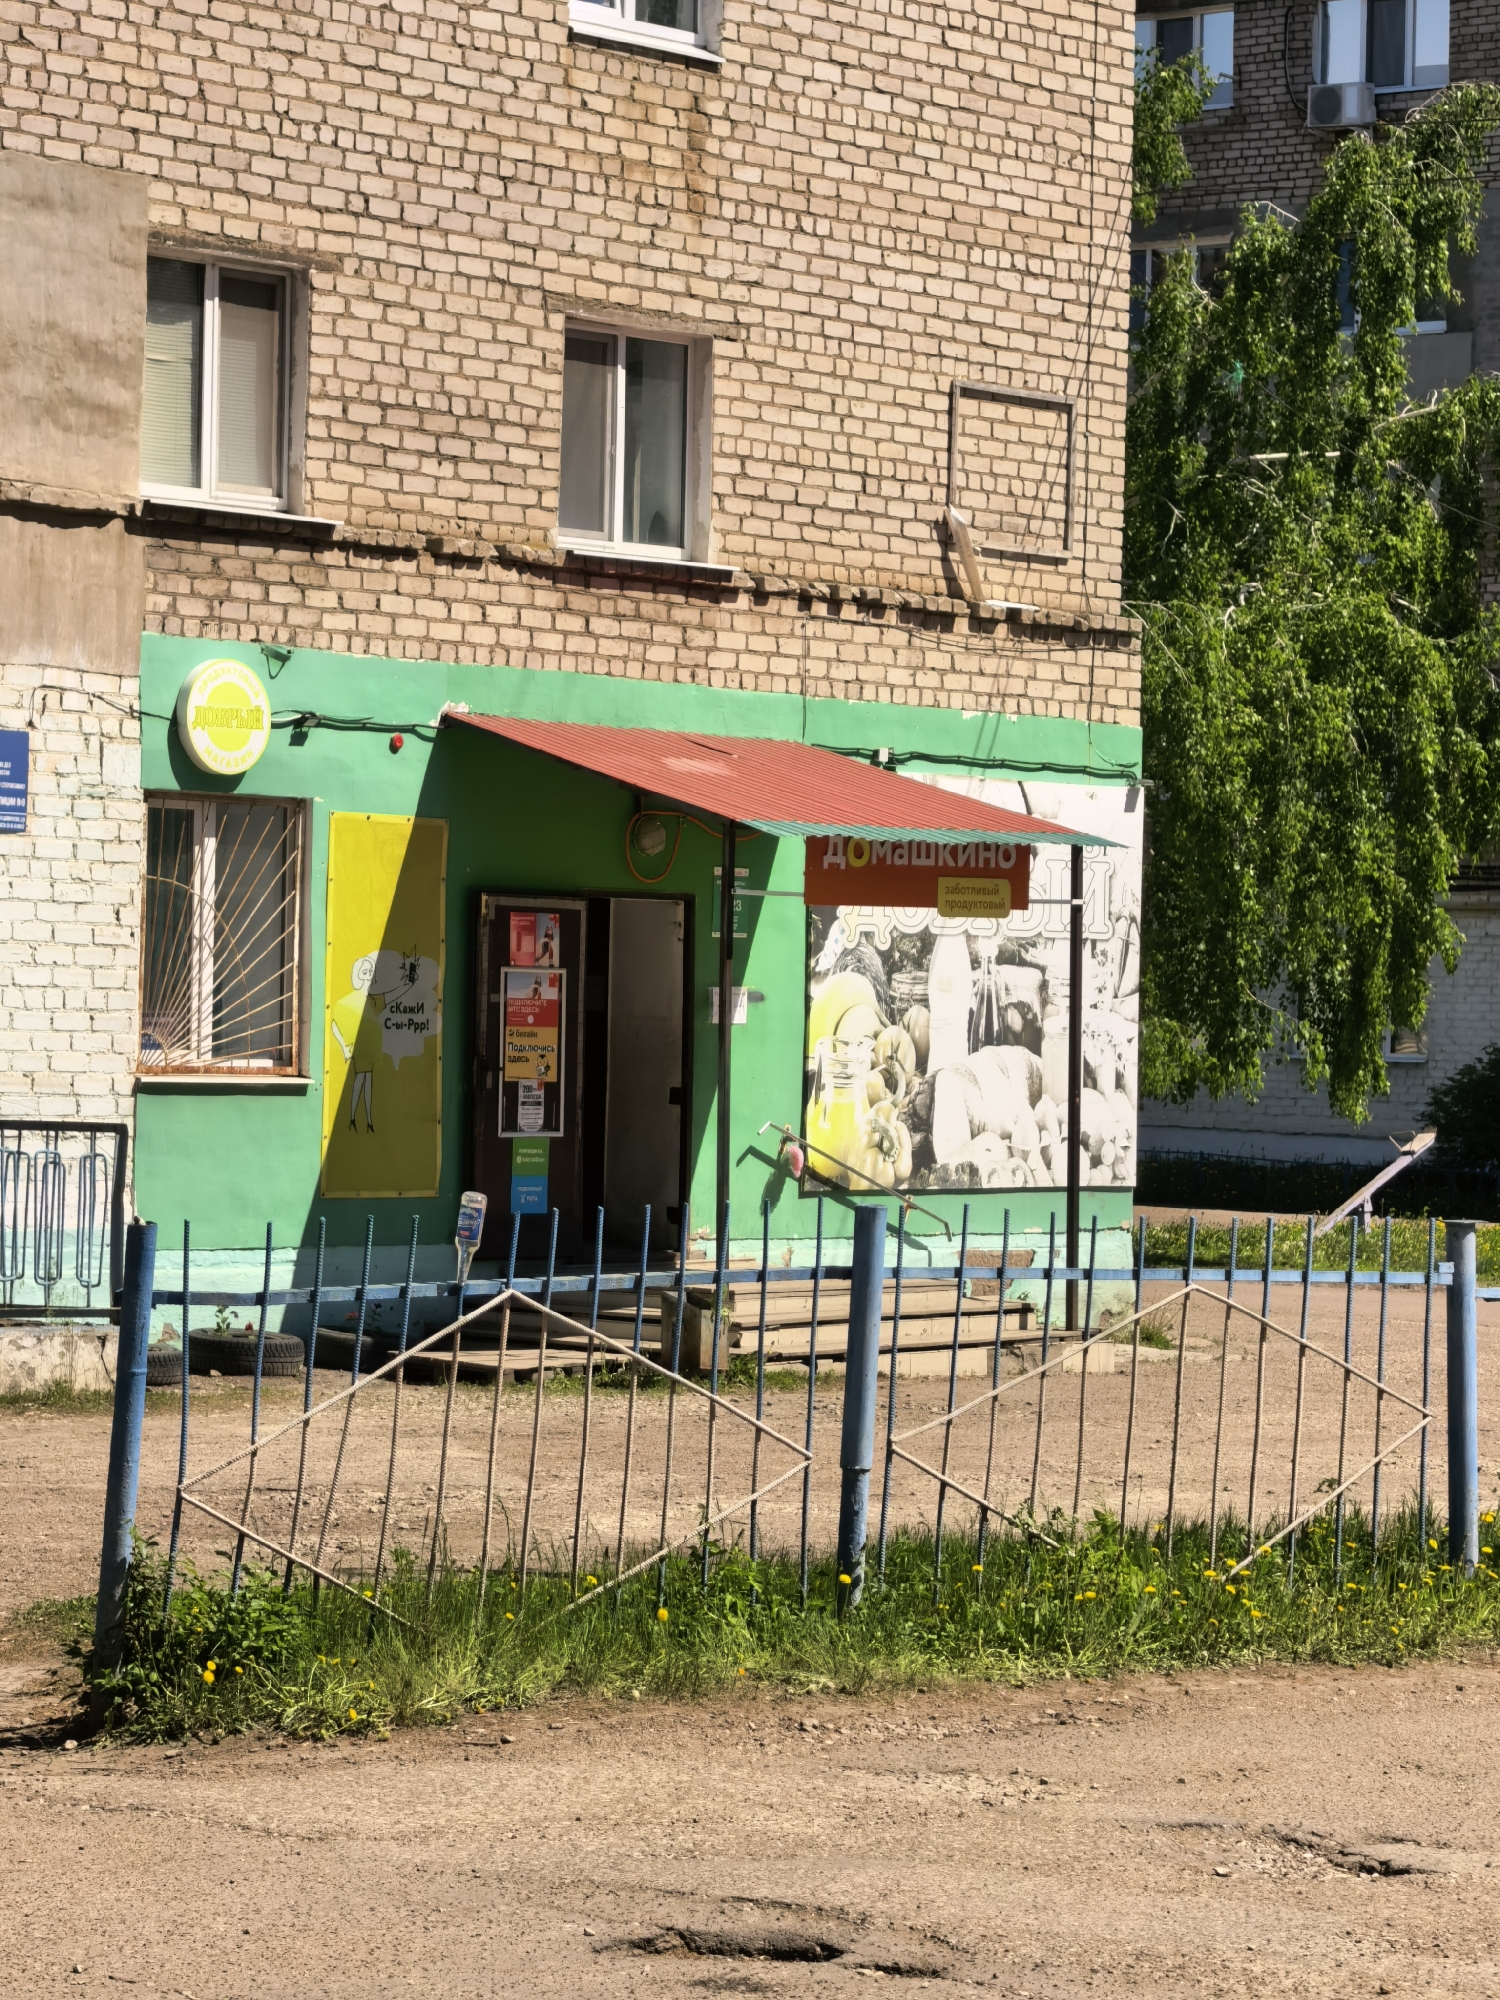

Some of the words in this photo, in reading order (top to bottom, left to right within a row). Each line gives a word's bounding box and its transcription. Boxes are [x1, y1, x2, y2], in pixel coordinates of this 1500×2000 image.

[192, 705, 264, 731] ДОБРЫЙ
[203, 746, 254, 768] МАГАЗИН
[945, 883, 1000, 896] заботливый
[945, 898, 1006, 912] продуктовый
[390, 1001, 424, 1015] сКажИ
[521, 1006, 540, 1014] ЗДЕСЬ
[384, 1017, 430, 1034] С-ы-Ррр!
[516, 1029, 538, 1038] билайн
[508, 1042, 556, 1053] Подключись
[508, 1055, 530, 1064] здесь
